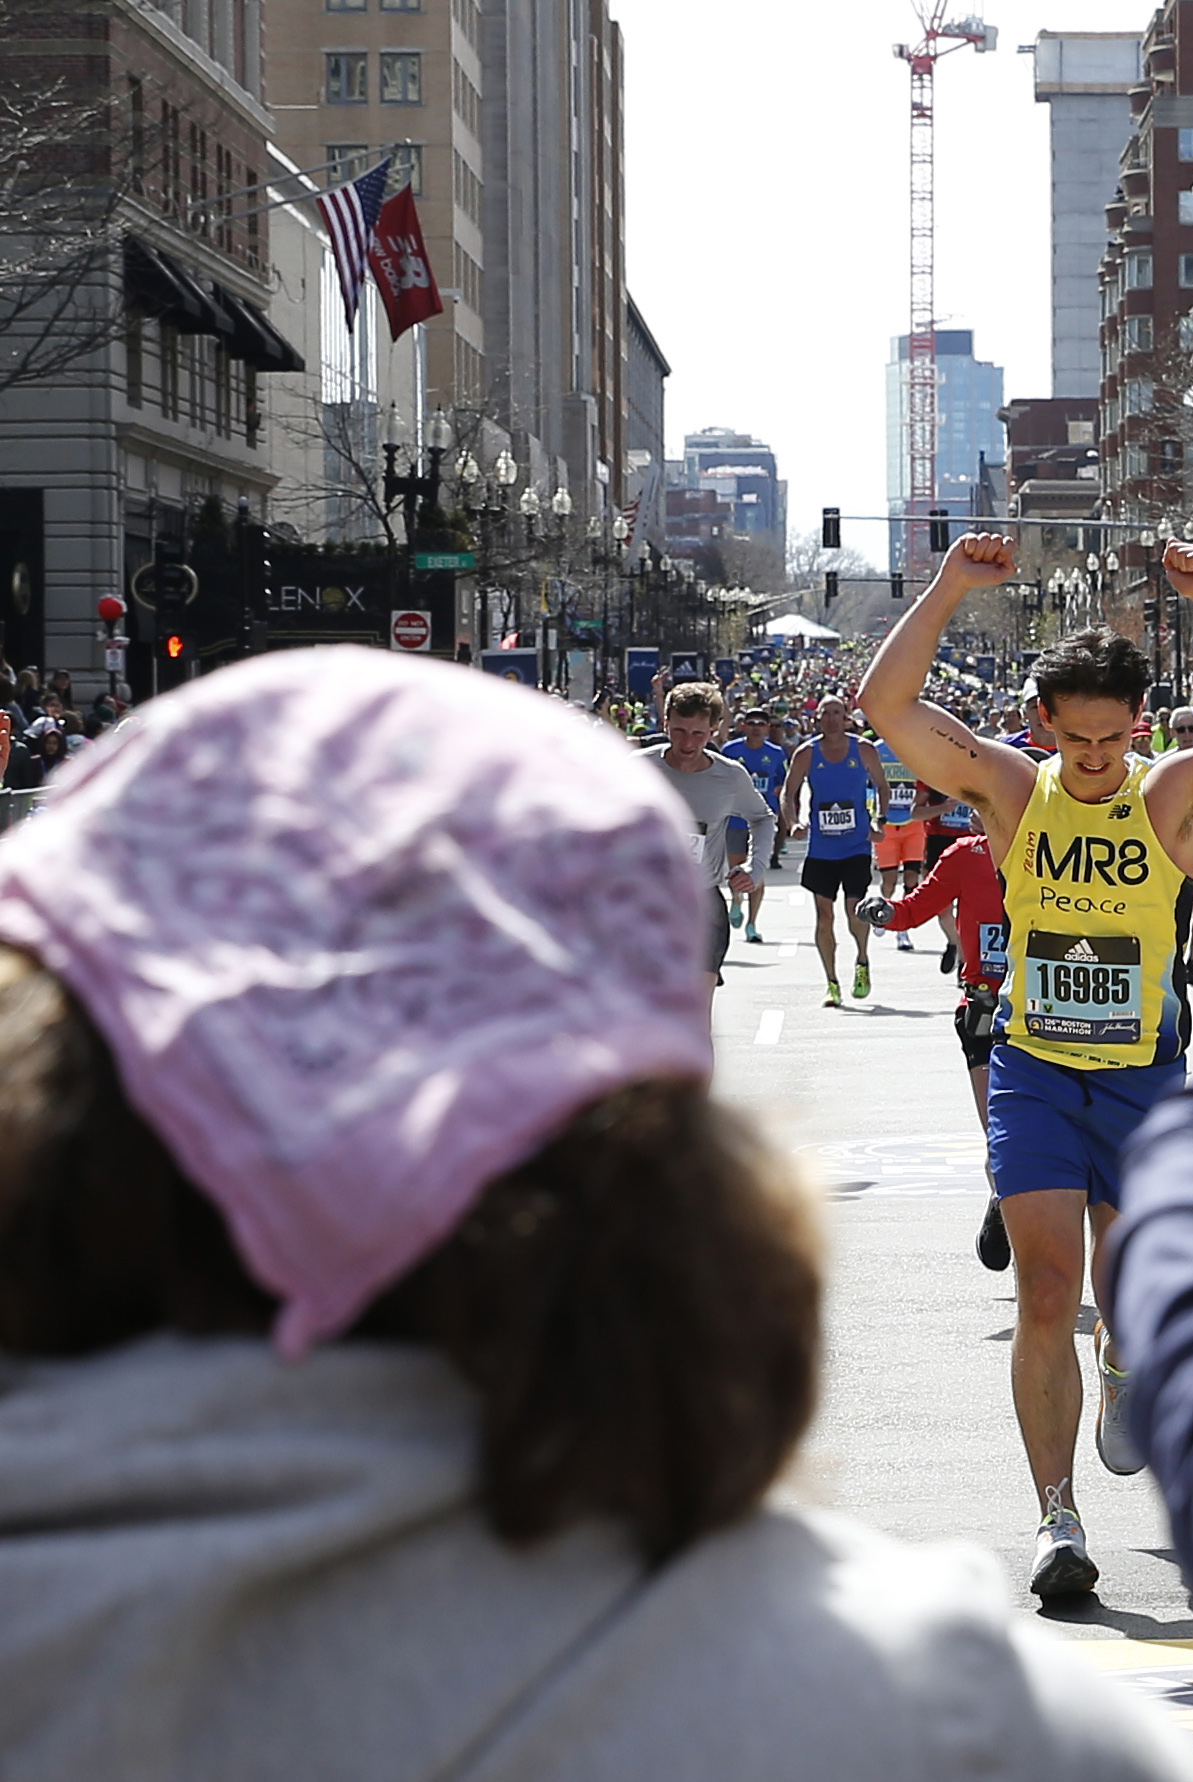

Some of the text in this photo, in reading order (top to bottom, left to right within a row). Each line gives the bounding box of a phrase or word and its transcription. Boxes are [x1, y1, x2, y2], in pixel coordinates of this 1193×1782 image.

[822, 811, 852, 826] 12005
[1036, 831, 1150, 888] MR8
[1040, 886, 1127, 915] Peace
[1064, 952, 1099, 963] adidas
[1036, 963, 1130, 1005] 16985
[1044, 1025, 1092, 1036] MARATHON
[1061, 1019, 1092, 1030] BOSTON
